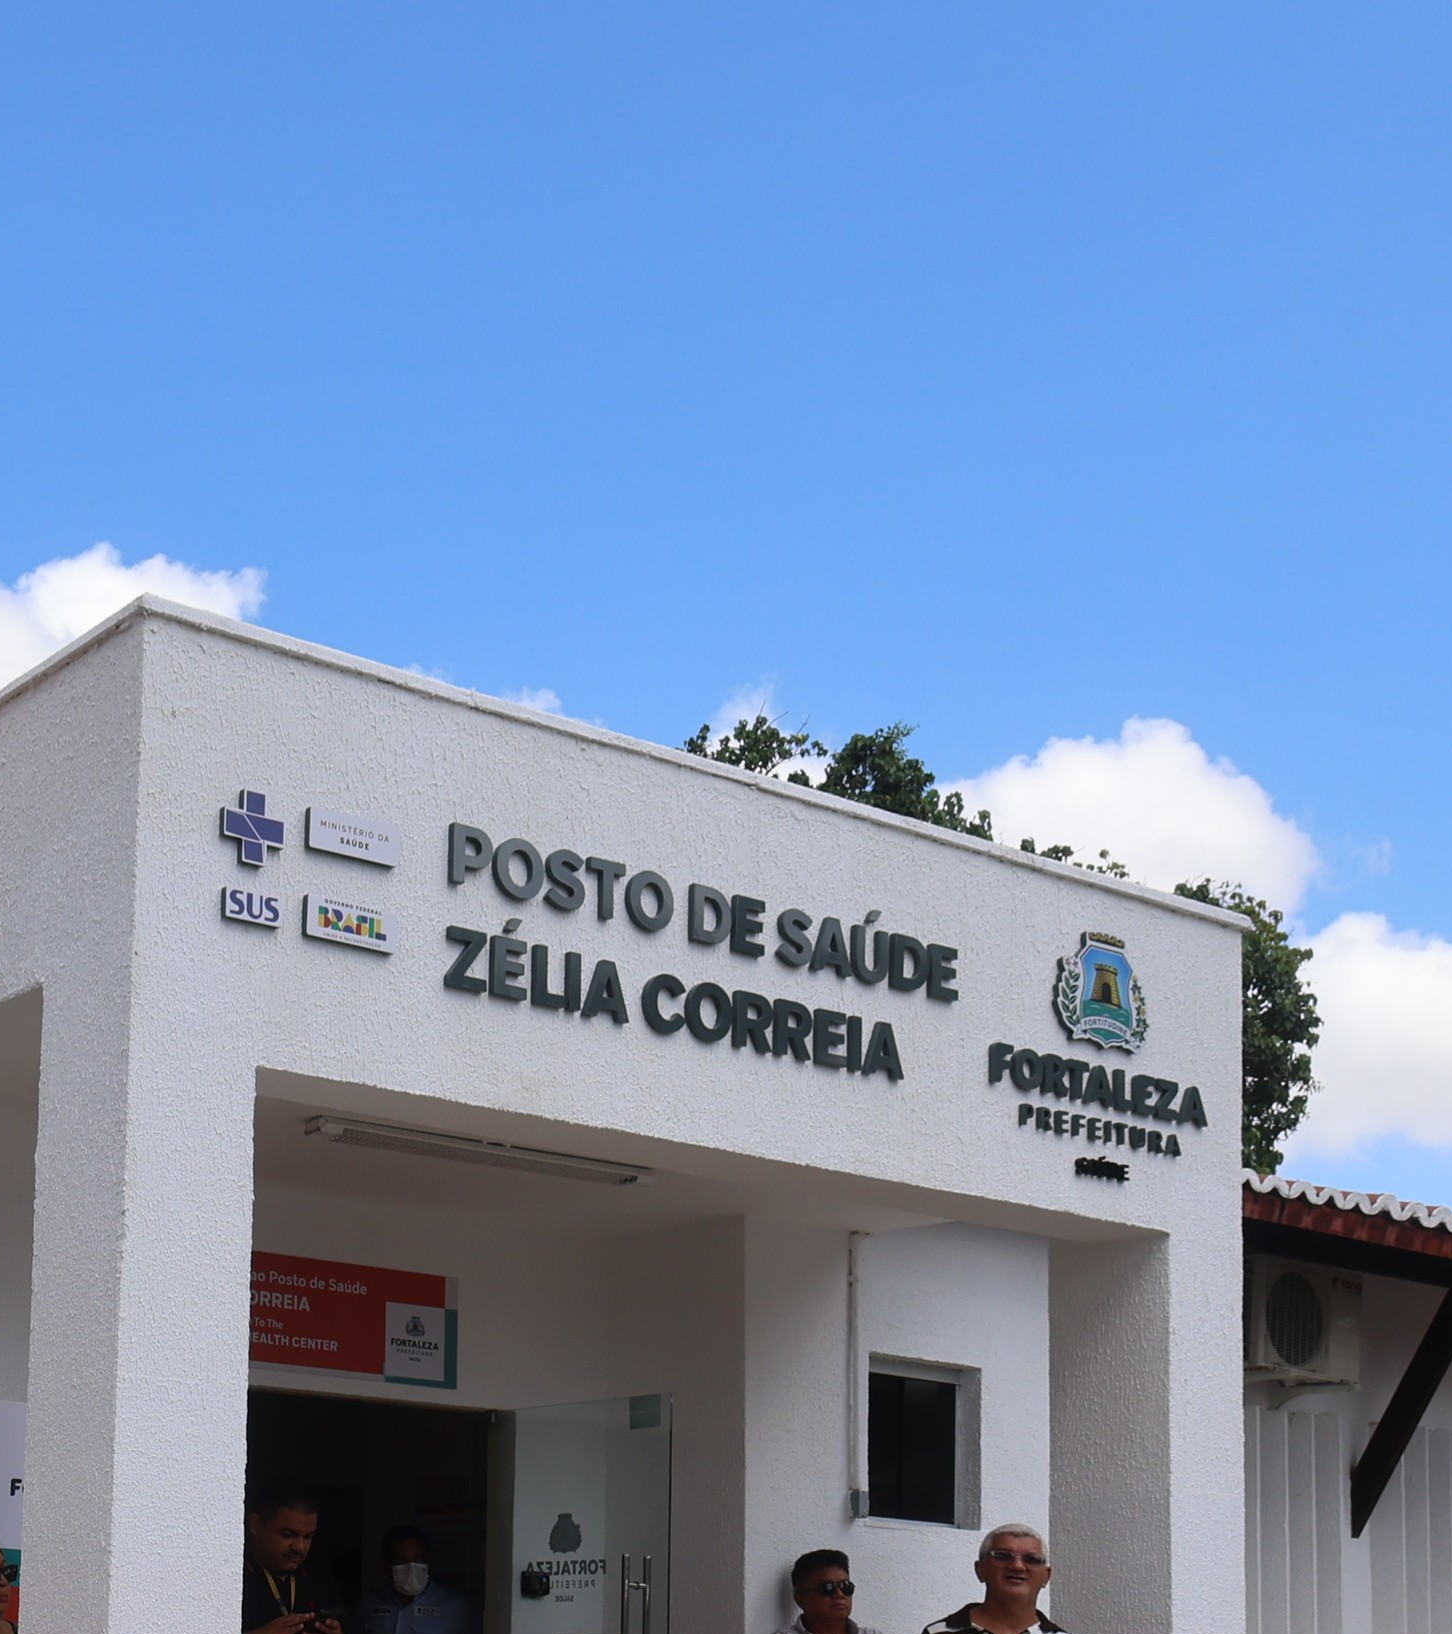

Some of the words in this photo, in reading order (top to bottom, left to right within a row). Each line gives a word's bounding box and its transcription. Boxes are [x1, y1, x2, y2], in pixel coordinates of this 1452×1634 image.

[320, 819, 375, 839] MINISTÉRIO
[378, 833, 390, 843] DA
[340, 837, 370, 851] SAÚDE
[228, 889, 280, 923] SUS
[324, 898, 354, 910] GOVERNO
[355, 905, 383, 917] FEDERAL
[448, 821, 675, 933] POSTO
[688, 882, 766, 958] DE
[775, 908, 960, 1002] SAÚDE
[318, 904, 387, 942] BRASIL
[442, 917, 630, 1025] ZÉLIA
[641, 972, 904, 1081] CORREIA
[1083, 1018, 1128, 1036] FORTITUDINE
[987, 1041, 1209, 1129] FORTALEZA
[1017, 1101, 1182, 1158] PREFEITURA
[269, 1270, 306, 1288] Posto
[309, 1276, 326, 1290] de
[328, 1278, 368, 1295] Saúde
[254, 1317, 266, 1328] To
[267, 1318, 284, 1329] The
[249, 1331, 290, 1346] EALTH
[292, 1336, 338, 1352] CENTER
[391, 1337, 439, 1351] FORTALEZA
